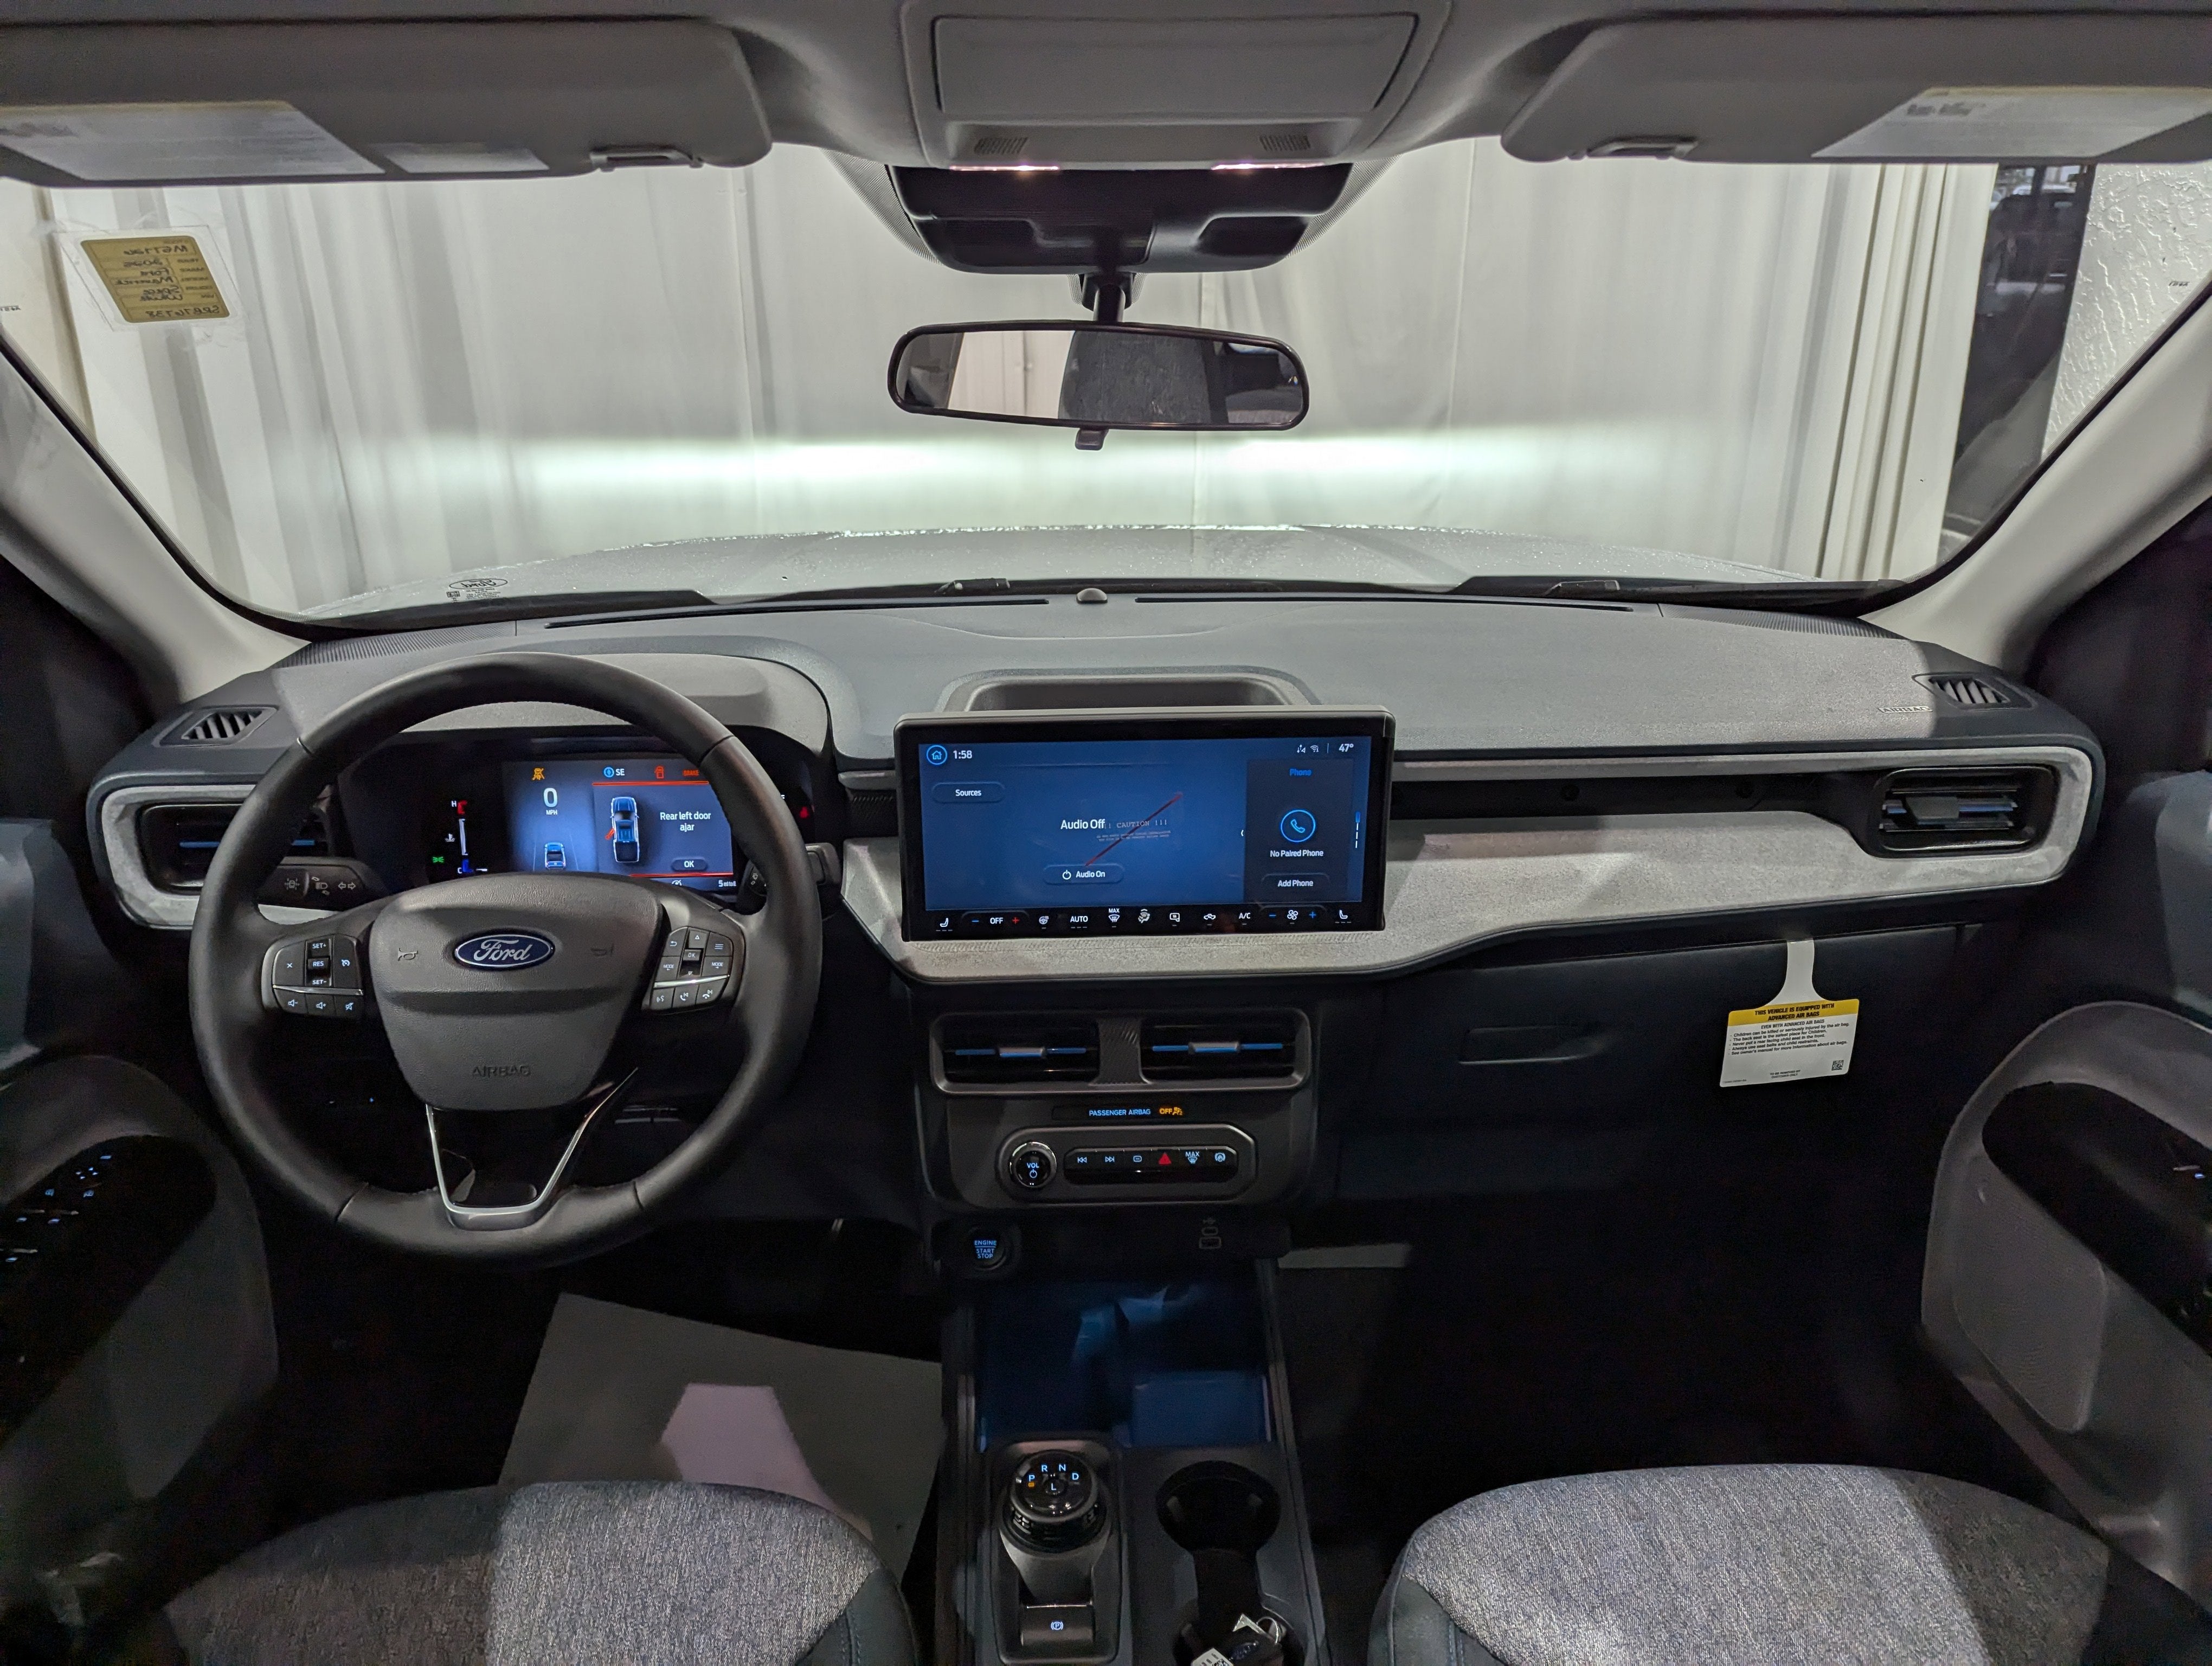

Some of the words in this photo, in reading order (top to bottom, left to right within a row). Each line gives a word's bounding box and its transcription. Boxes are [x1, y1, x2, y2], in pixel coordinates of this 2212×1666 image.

[953, 750, 973, 759] 1:58
[615, 768, 625, 776] SE
[543, 787, 558, 808] 0
[660, 812, 678, 820] Rear
[679, 812, 692, 820] left
[694, 812, 711, 820] door
[680, 823, 695, 832] ajar
[1060, 819, 1088, 830] Audio
[1090, 818, 1105, 829] Off
[1281, 849, 1301, 857] Paired
[473, 939, 533, 961] Ford
[472, 1065, 531, 1077] AIRBAG
